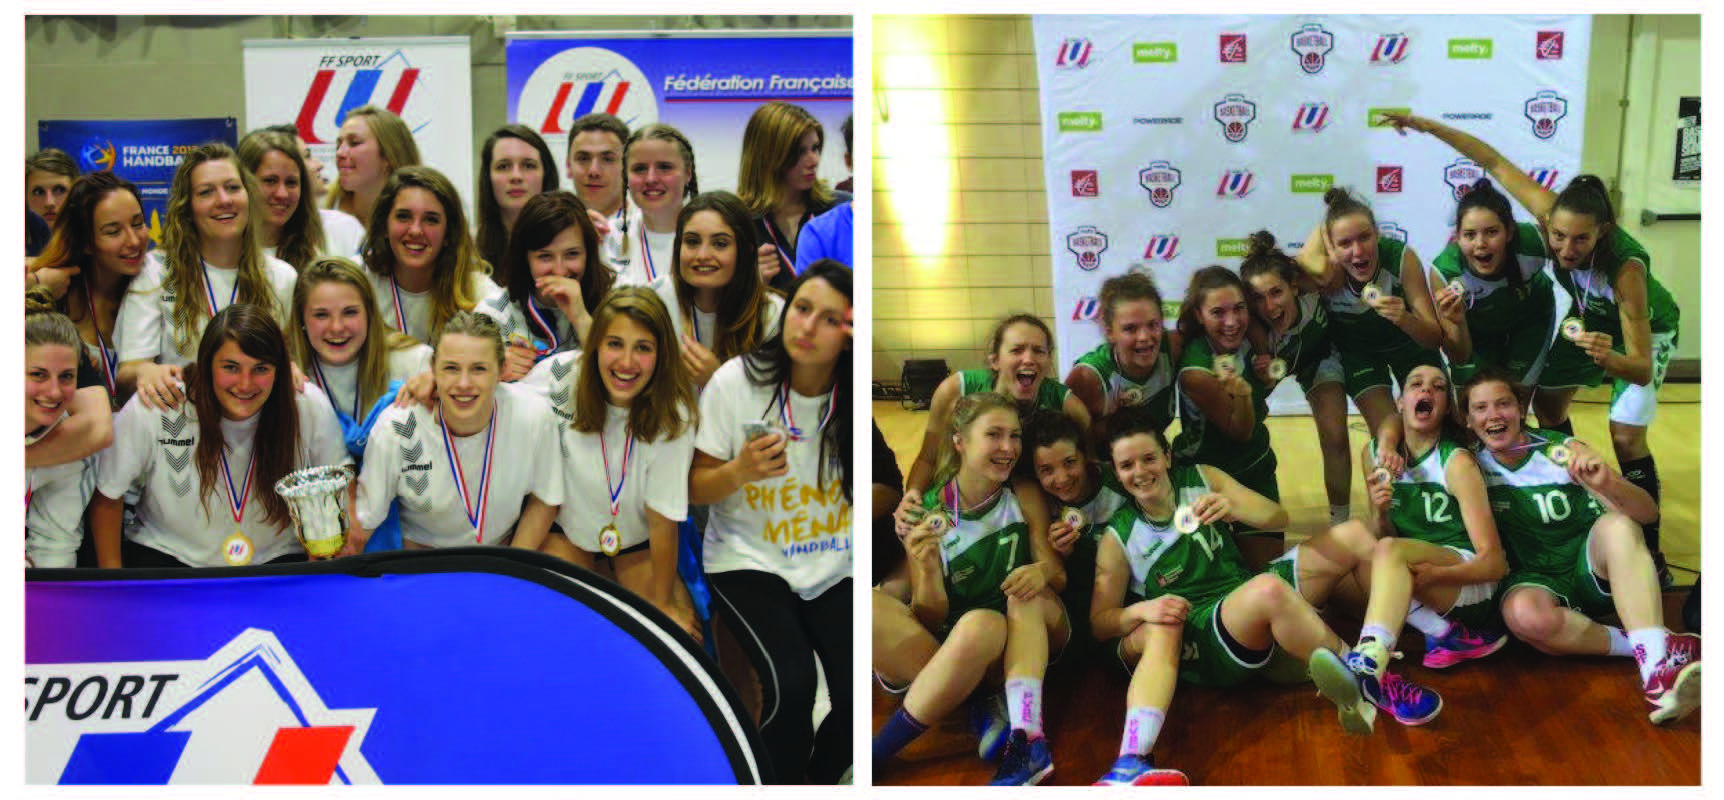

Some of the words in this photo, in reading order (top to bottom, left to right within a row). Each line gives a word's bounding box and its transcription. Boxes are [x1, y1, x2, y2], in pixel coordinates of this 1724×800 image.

[320, 55, 336, 67] FF
[336, 55, 381, 67] SPORT
[663, 73, 764, 92] Fédération
[122, 145, 170, 155] FRANCE
[122, 155, 184, 167] HANDBA
[141, 187, 169, 195] MONDE
[401, 459, 433, 473] ummel
[1421, 490, 1452, 523] 12
[1532, 489, 1572, 524] 10
[1191, 525, 1224, 562] 14
[999, 532, 1020, 573] 7
